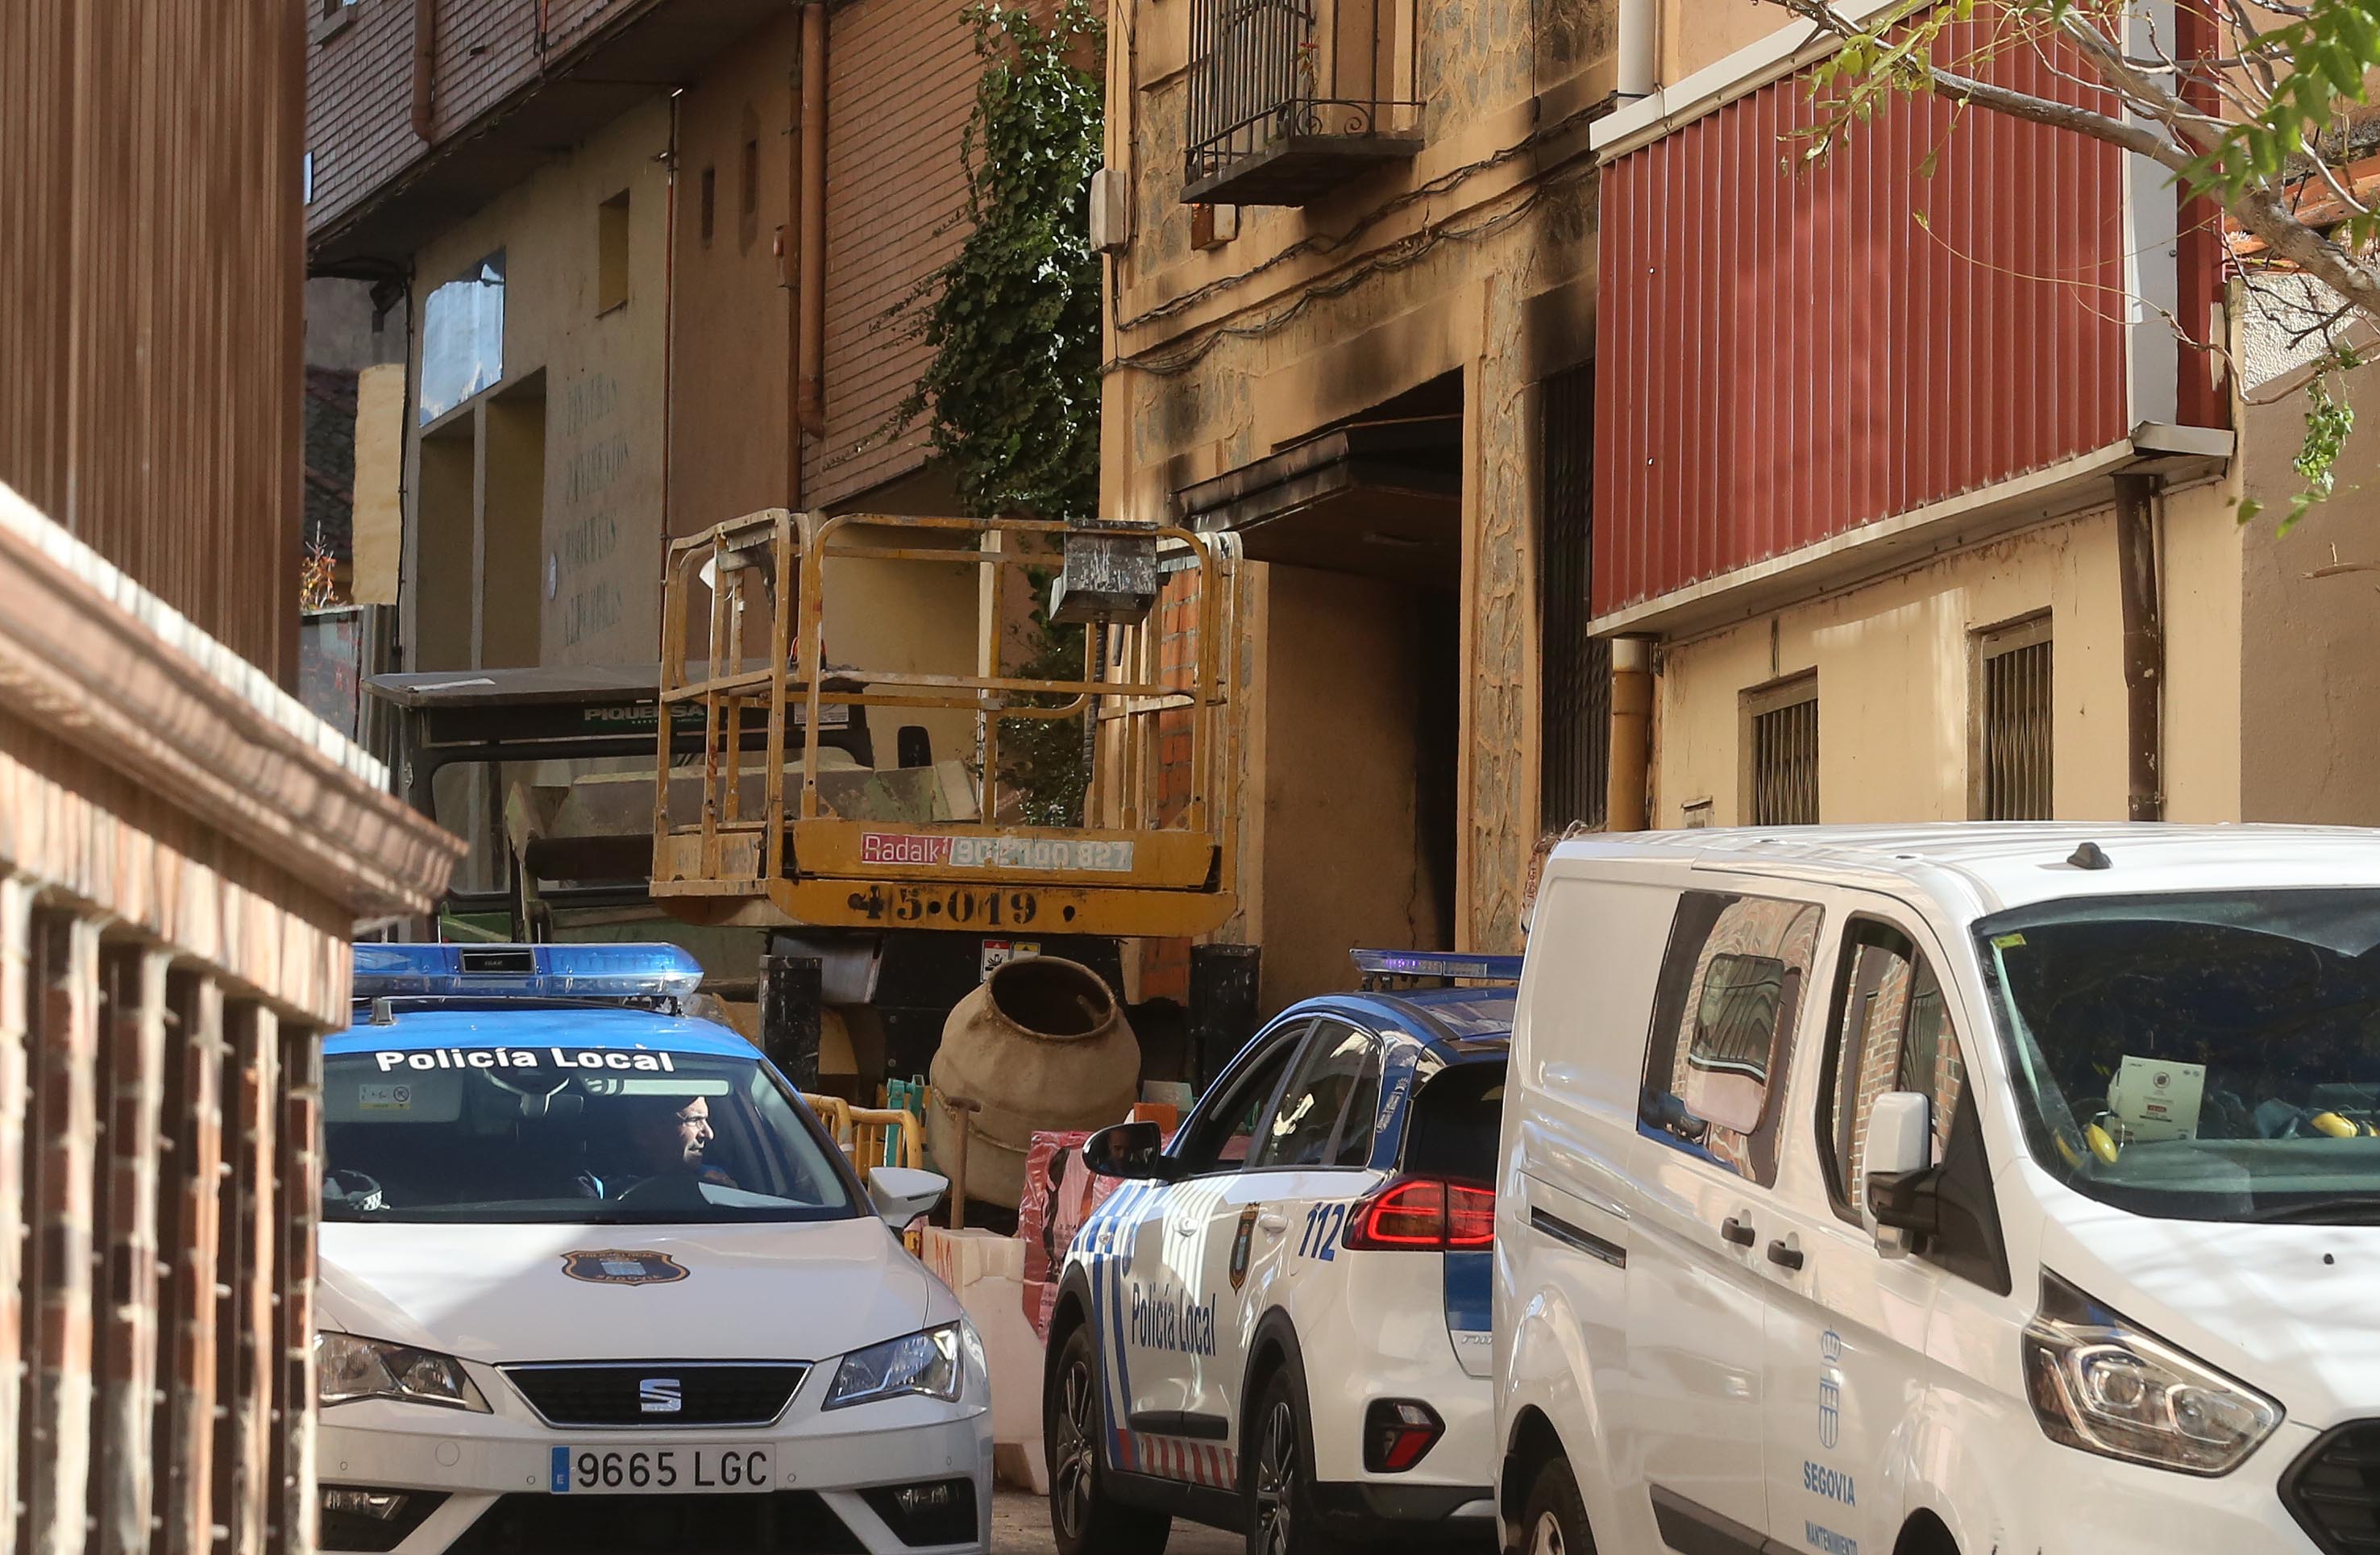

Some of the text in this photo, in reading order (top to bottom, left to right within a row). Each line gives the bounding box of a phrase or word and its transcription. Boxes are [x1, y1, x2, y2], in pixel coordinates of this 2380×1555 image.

[1019, 841, 1070, 867] 100
[374, 1047, 676, 1073] Policía Local
[1298, 1202, 1346, 1262] 112
[1132, 1282, 1217, 1358] Policía Local
[577, 1451, 677, 1487] 9665
[695, 1451, 767, 1487] LGC
[1804, 1460, 1855, 1507] SEGOVIA
